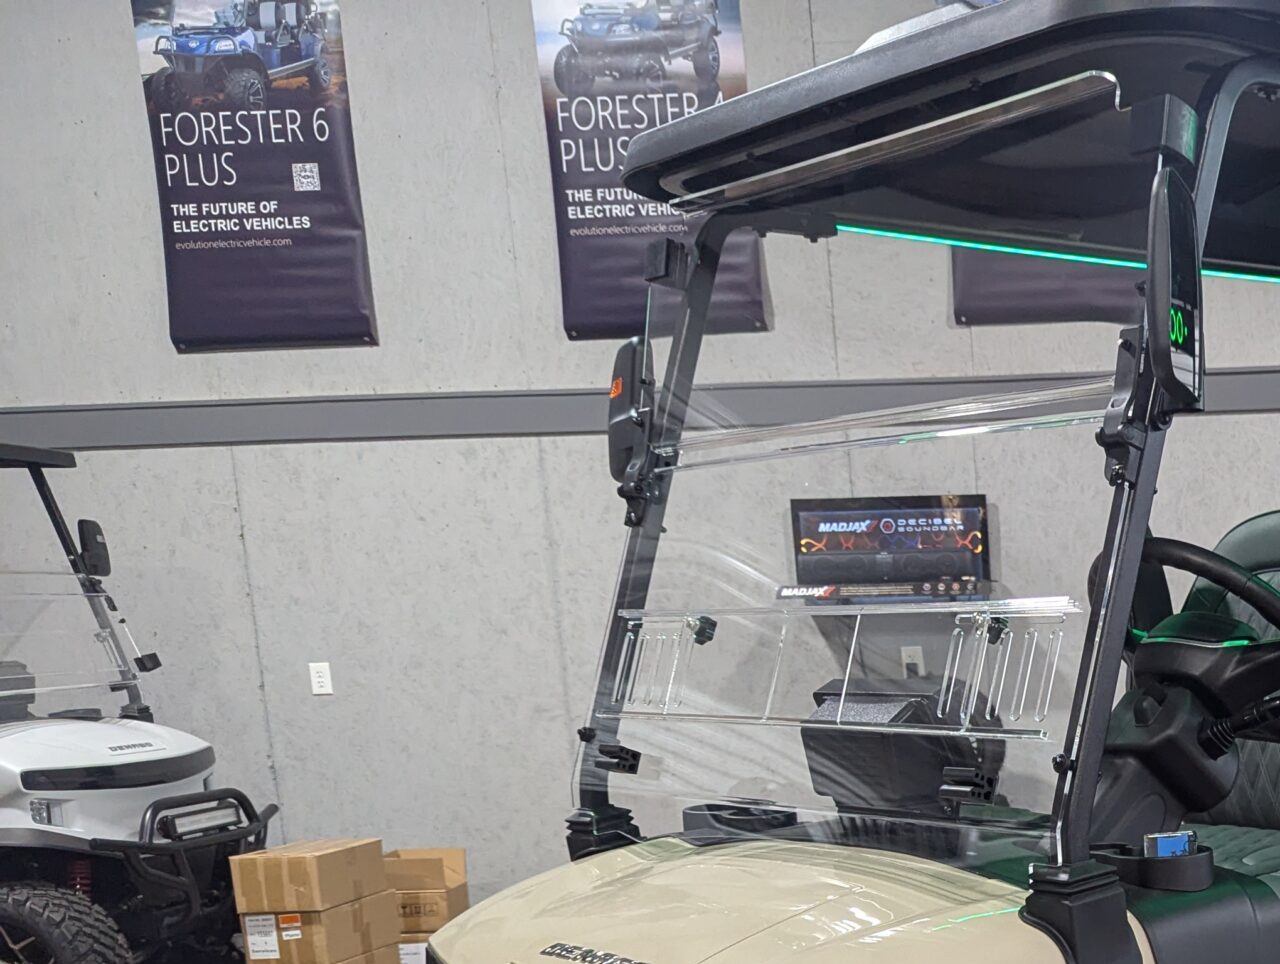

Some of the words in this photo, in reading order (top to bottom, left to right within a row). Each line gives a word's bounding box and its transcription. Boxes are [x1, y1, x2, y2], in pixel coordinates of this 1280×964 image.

[556, 92, 699, 132] FORESTER
[159, 108, 304, 147] FORESTER
[312, 107, 330, 142] 6
[164, 152, 237, 187] PLUS
[565, 189, 594, 203] THE
[170, 203, 199, 216] THE
[202, 201, 256, 216] FUTURE
[259, 201, 279, 214] OF
[567, 204, 635, 219] ELECTRIC
[173, 218, 240, 233] ELECTRIC
[243, 216, 311, 231] VEHICLES
[175, 237, 292, 250] evolutionelectricvehicle.com
[818, 519, 878, 534] MADJAX
[897, 518, 962, 526] DECIBEL
[780, 585, 836, 598] MADJAX
